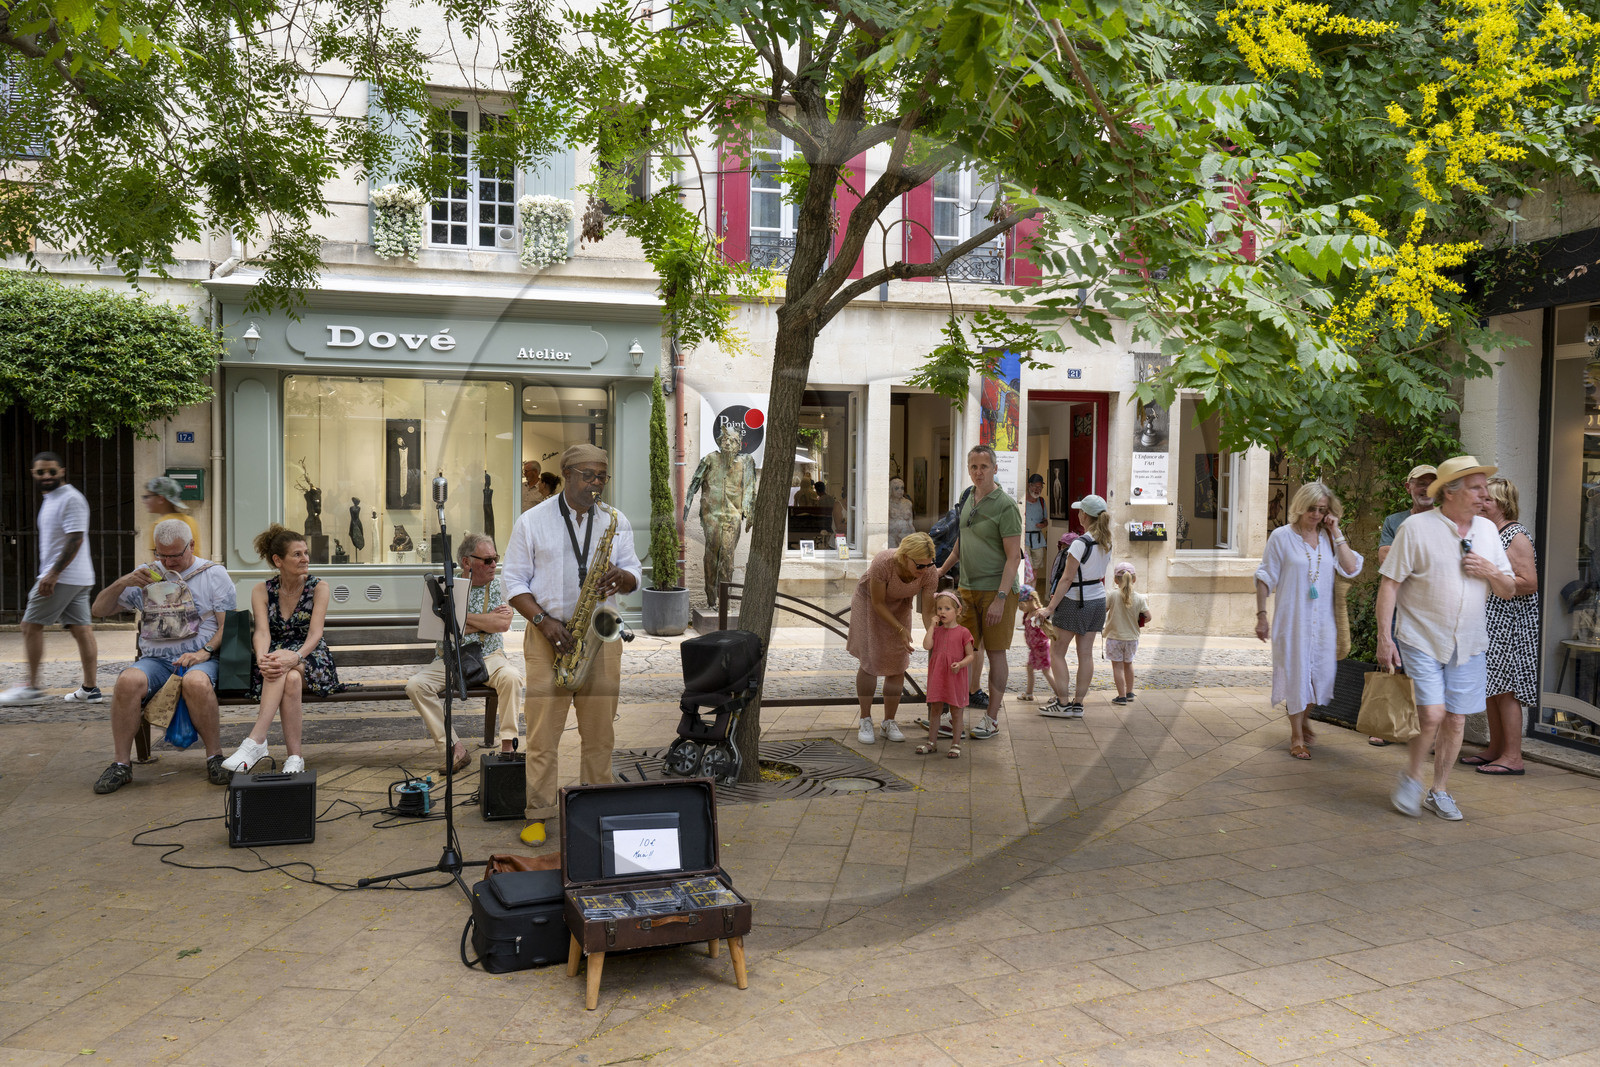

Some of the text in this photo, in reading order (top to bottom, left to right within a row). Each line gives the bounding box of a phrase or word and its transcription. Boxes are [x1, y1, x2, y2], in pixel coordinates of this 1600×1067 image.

[326, 325, 457, 351] Dové
[516, 347, 572, 361] Atelier
[719, 415, 745, 430] Point
[179, 433, 192, 441] 17c
